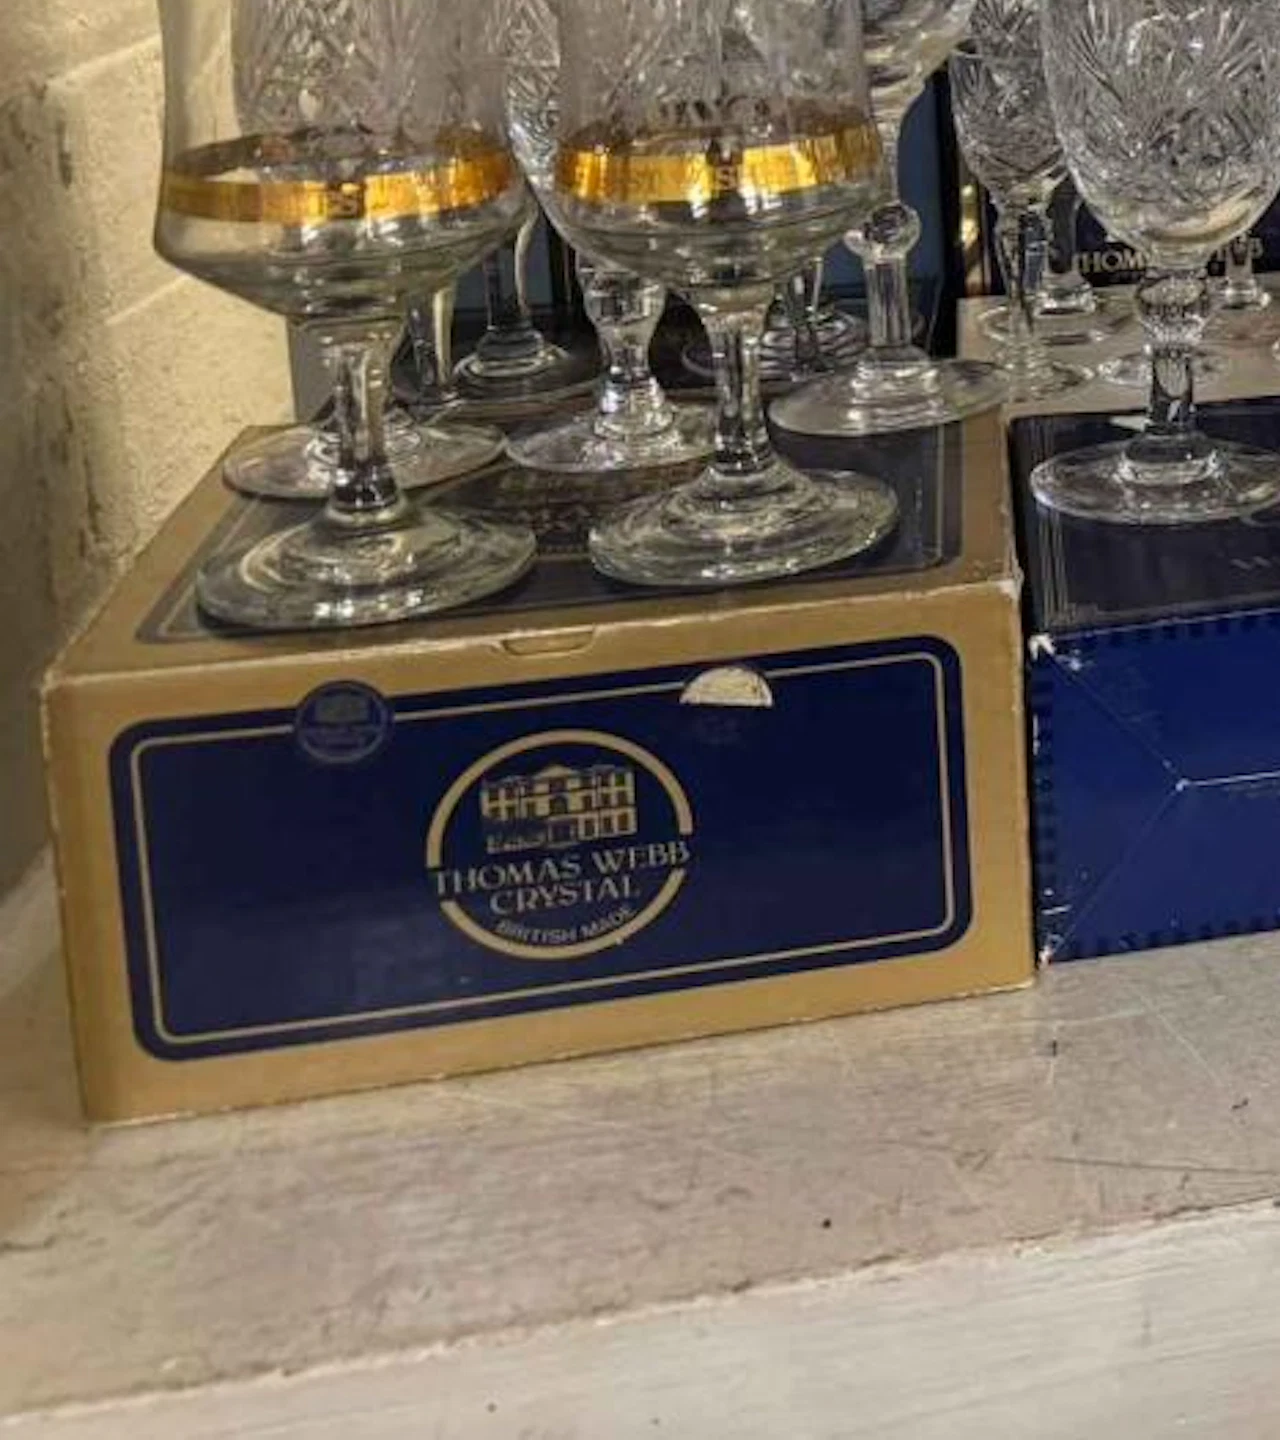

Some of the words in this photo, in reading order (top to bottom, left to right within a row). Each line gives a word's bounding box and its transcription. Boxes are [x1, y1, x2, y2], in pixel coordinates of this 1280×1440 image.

[436, 856, 581, 895] THOMAS
[592, 841, 690, 874] WEBB
[490, 877, 642, 915] CRYSTAL
[496, 919, 577, 944] BRITISH
[581, 906, 636, 940] MADE
